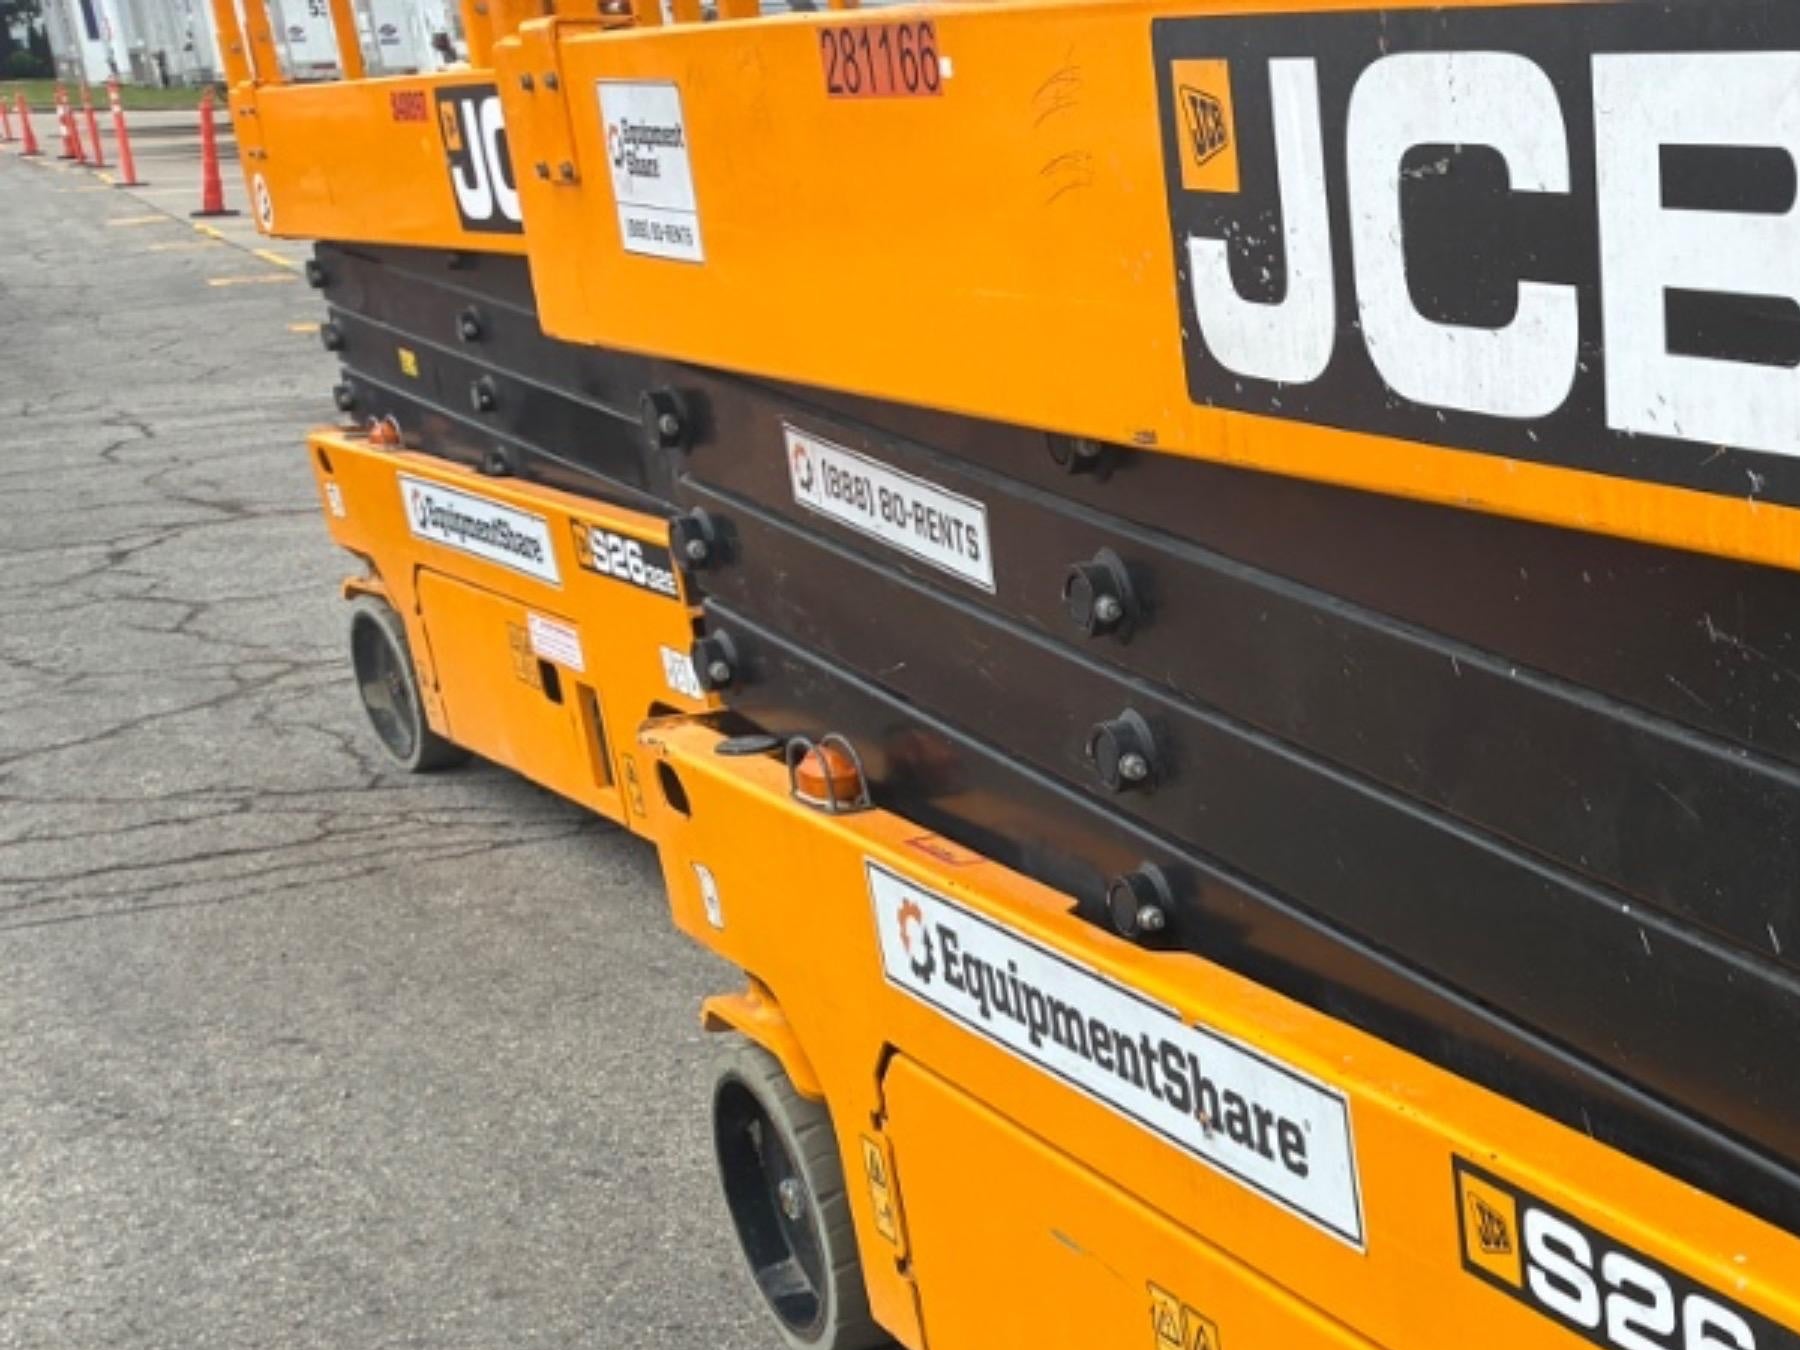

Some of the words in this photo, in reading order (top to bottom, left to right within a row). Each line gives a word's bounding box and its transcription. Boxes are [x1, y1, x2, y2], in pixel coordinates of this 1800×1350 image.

[820, 20, 940, 94] 281166
[452, 96, 523, 221] JC
[591, 527, 647, 587] S26
[821, 458, 875, 518] (888)
[878, 485, 980, 562] 80-RENTS
[935, 920, 1311, 1179] EquipmentShare
